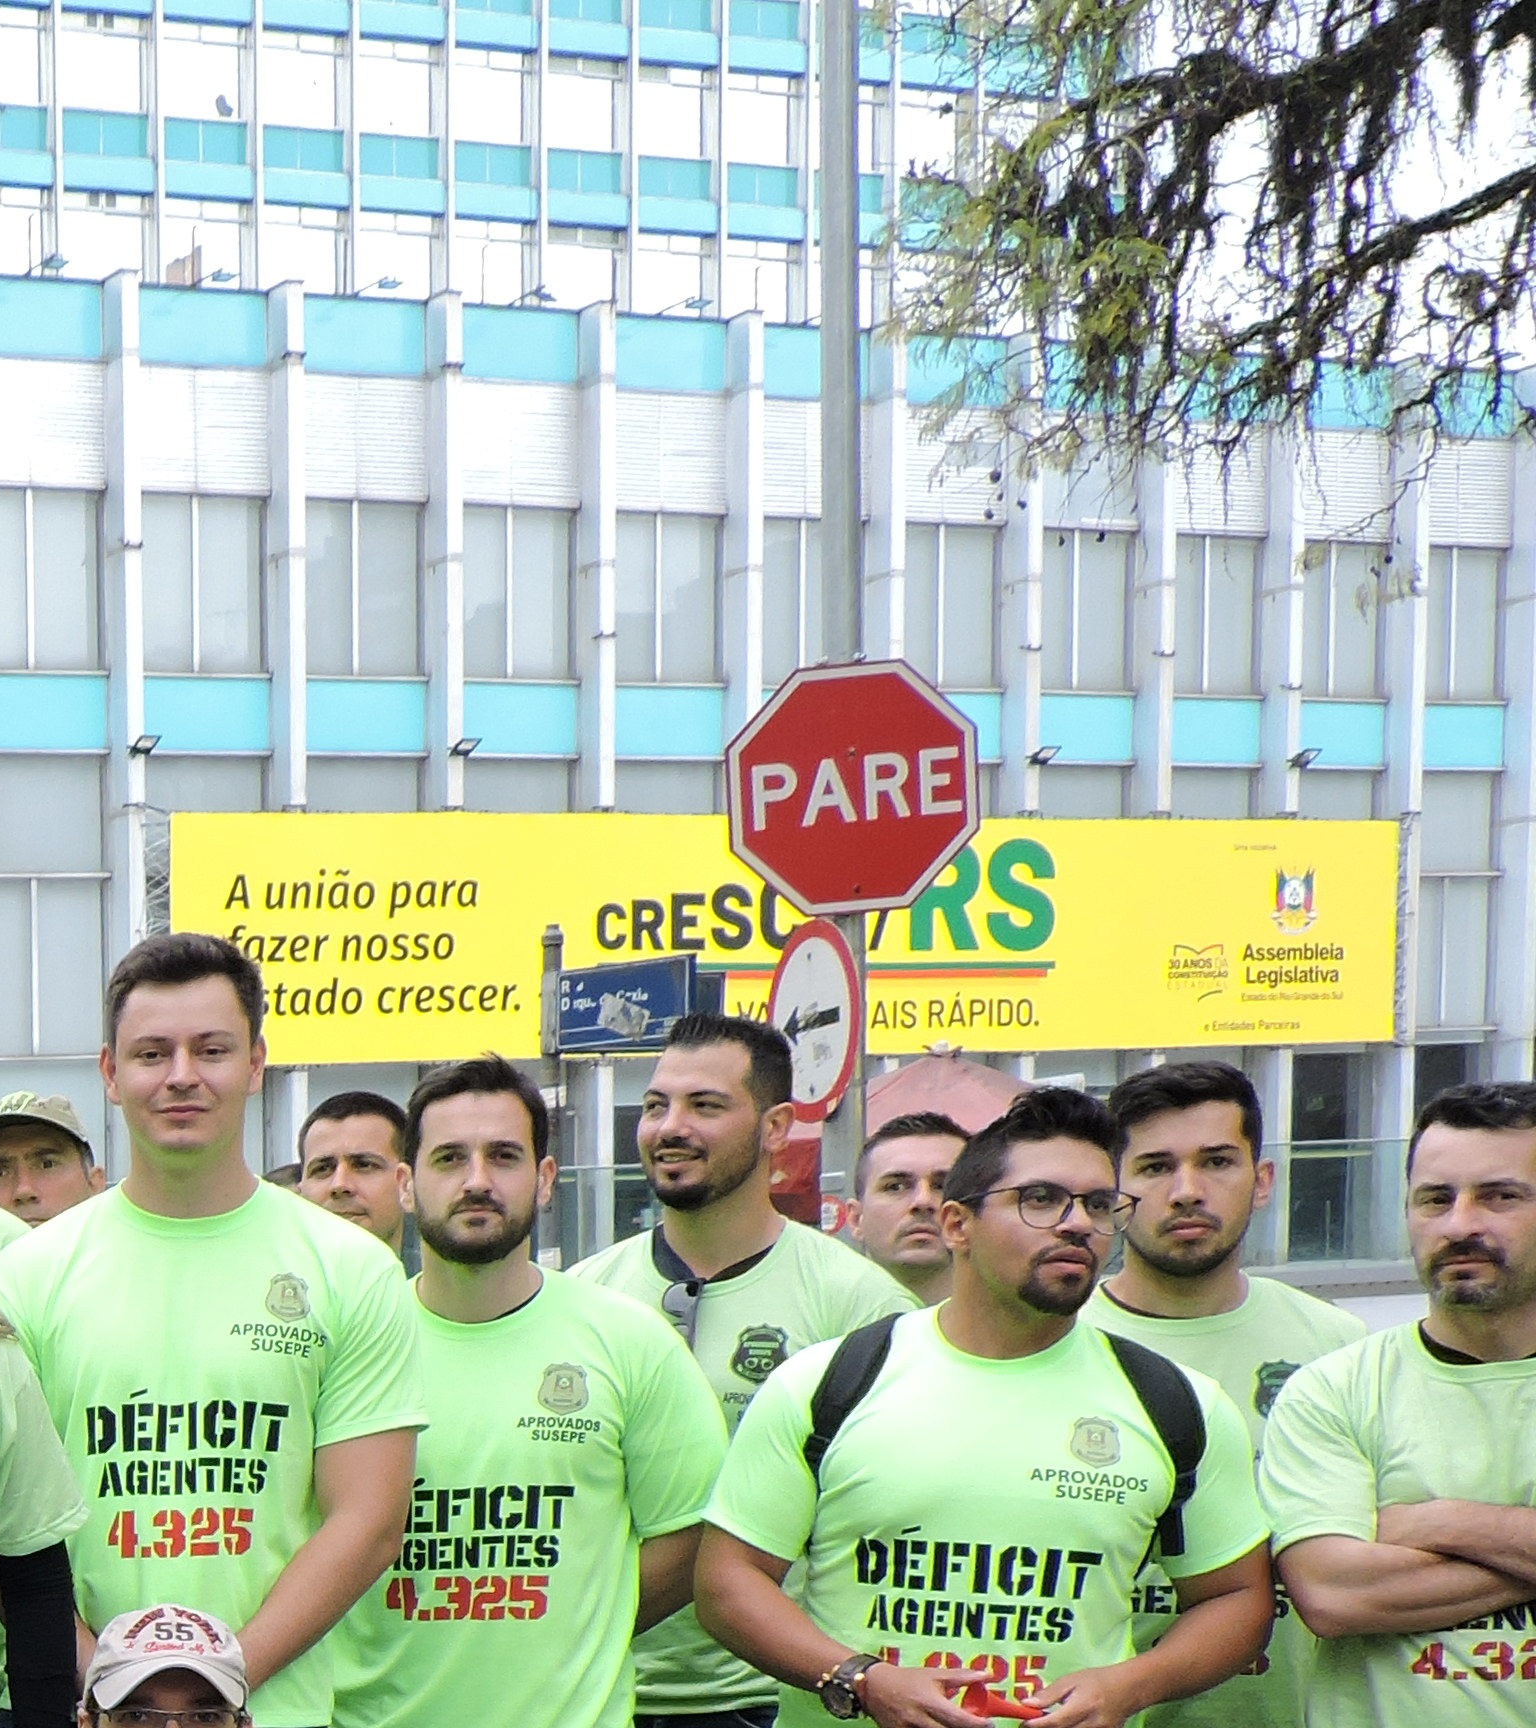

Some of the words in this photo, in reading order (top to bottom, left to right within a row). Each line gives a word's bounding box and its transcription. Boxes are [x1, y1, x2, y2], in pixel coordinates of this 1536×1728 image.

[750, 746, 963, 831] PARE
[225, 873, 251, 910] A
[266, 868, 376, 910] união
[389, 877, 479, 919] para
[341, 931, 455, 962] nosso
[1242, 942, 1344, 961] Assembleia
[1245, 965, 1340, 989] Legislativa
[377, 982, 522, 1013] crescer.
[927, 992, 1040, 1029] RÁPIDO.
[229, 1323, 328, 1348] APROVADOS
[250, 1337, 311, 1358] SUSEPE
[85, 1389, 291, 1456] DÉFICIT
[516, 1415, 602, 1433] APROVADOS
[531, 1428, 587, 1444] SUSEPE
[97, 1457, 269, 1499] AGENTES
[1030, 1467, 1149, 1494] APROVADOS
[1055, 1484, 1127, 1505] SUSEPE
[107, 1507, 255, 1560] 4.325
[854, 1526, 1103, 1600] DÉFICIT
[385, 1575, 551, 1622] 4.325
[154, 1621, 194, 1642] 55
[866, 1594, 1075, 1643] AGENTES
